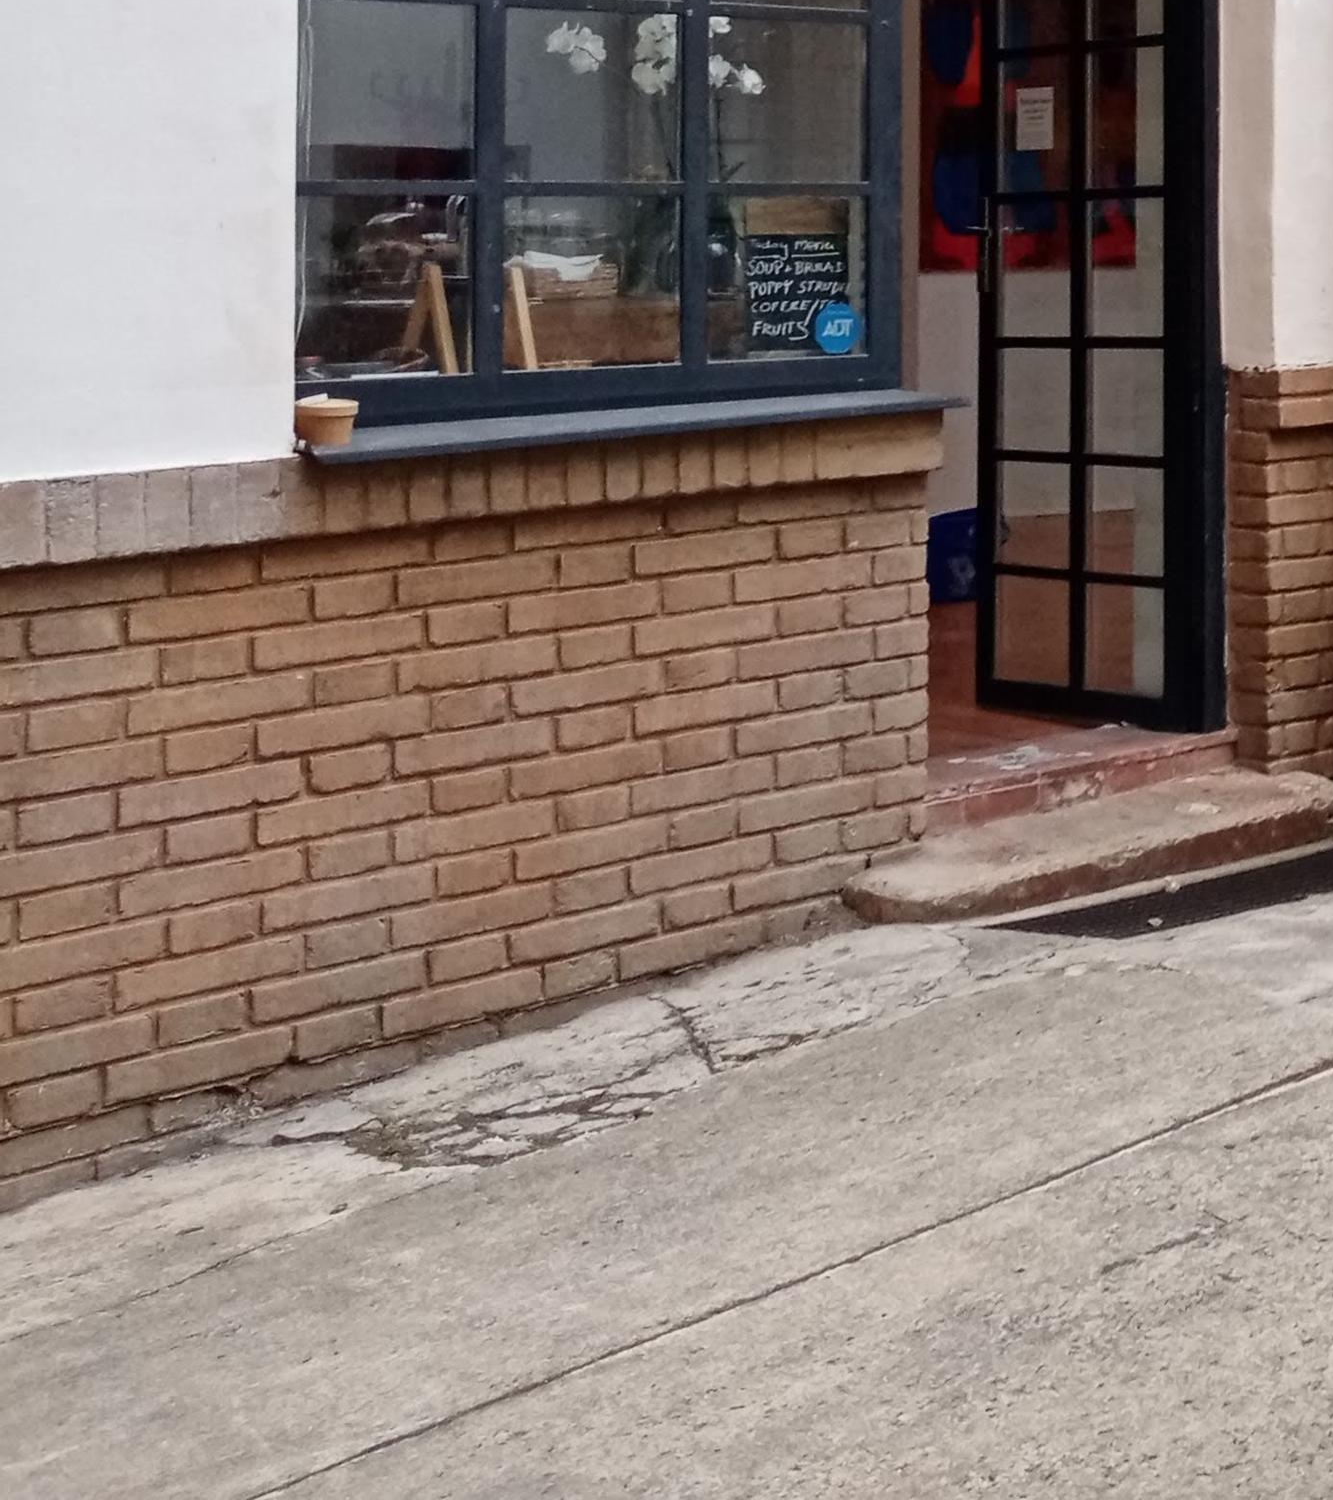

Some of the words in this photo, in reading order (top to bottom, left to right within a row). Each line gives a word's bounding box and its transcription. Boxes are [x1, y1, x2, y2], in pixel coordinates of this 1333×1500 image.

[745, 260, 784, 277] SOUP
[747, 279, 794, 300] POPPY
[751, 320, 809, 341] FRUITS
[821, 318, 855, 338] ADT
